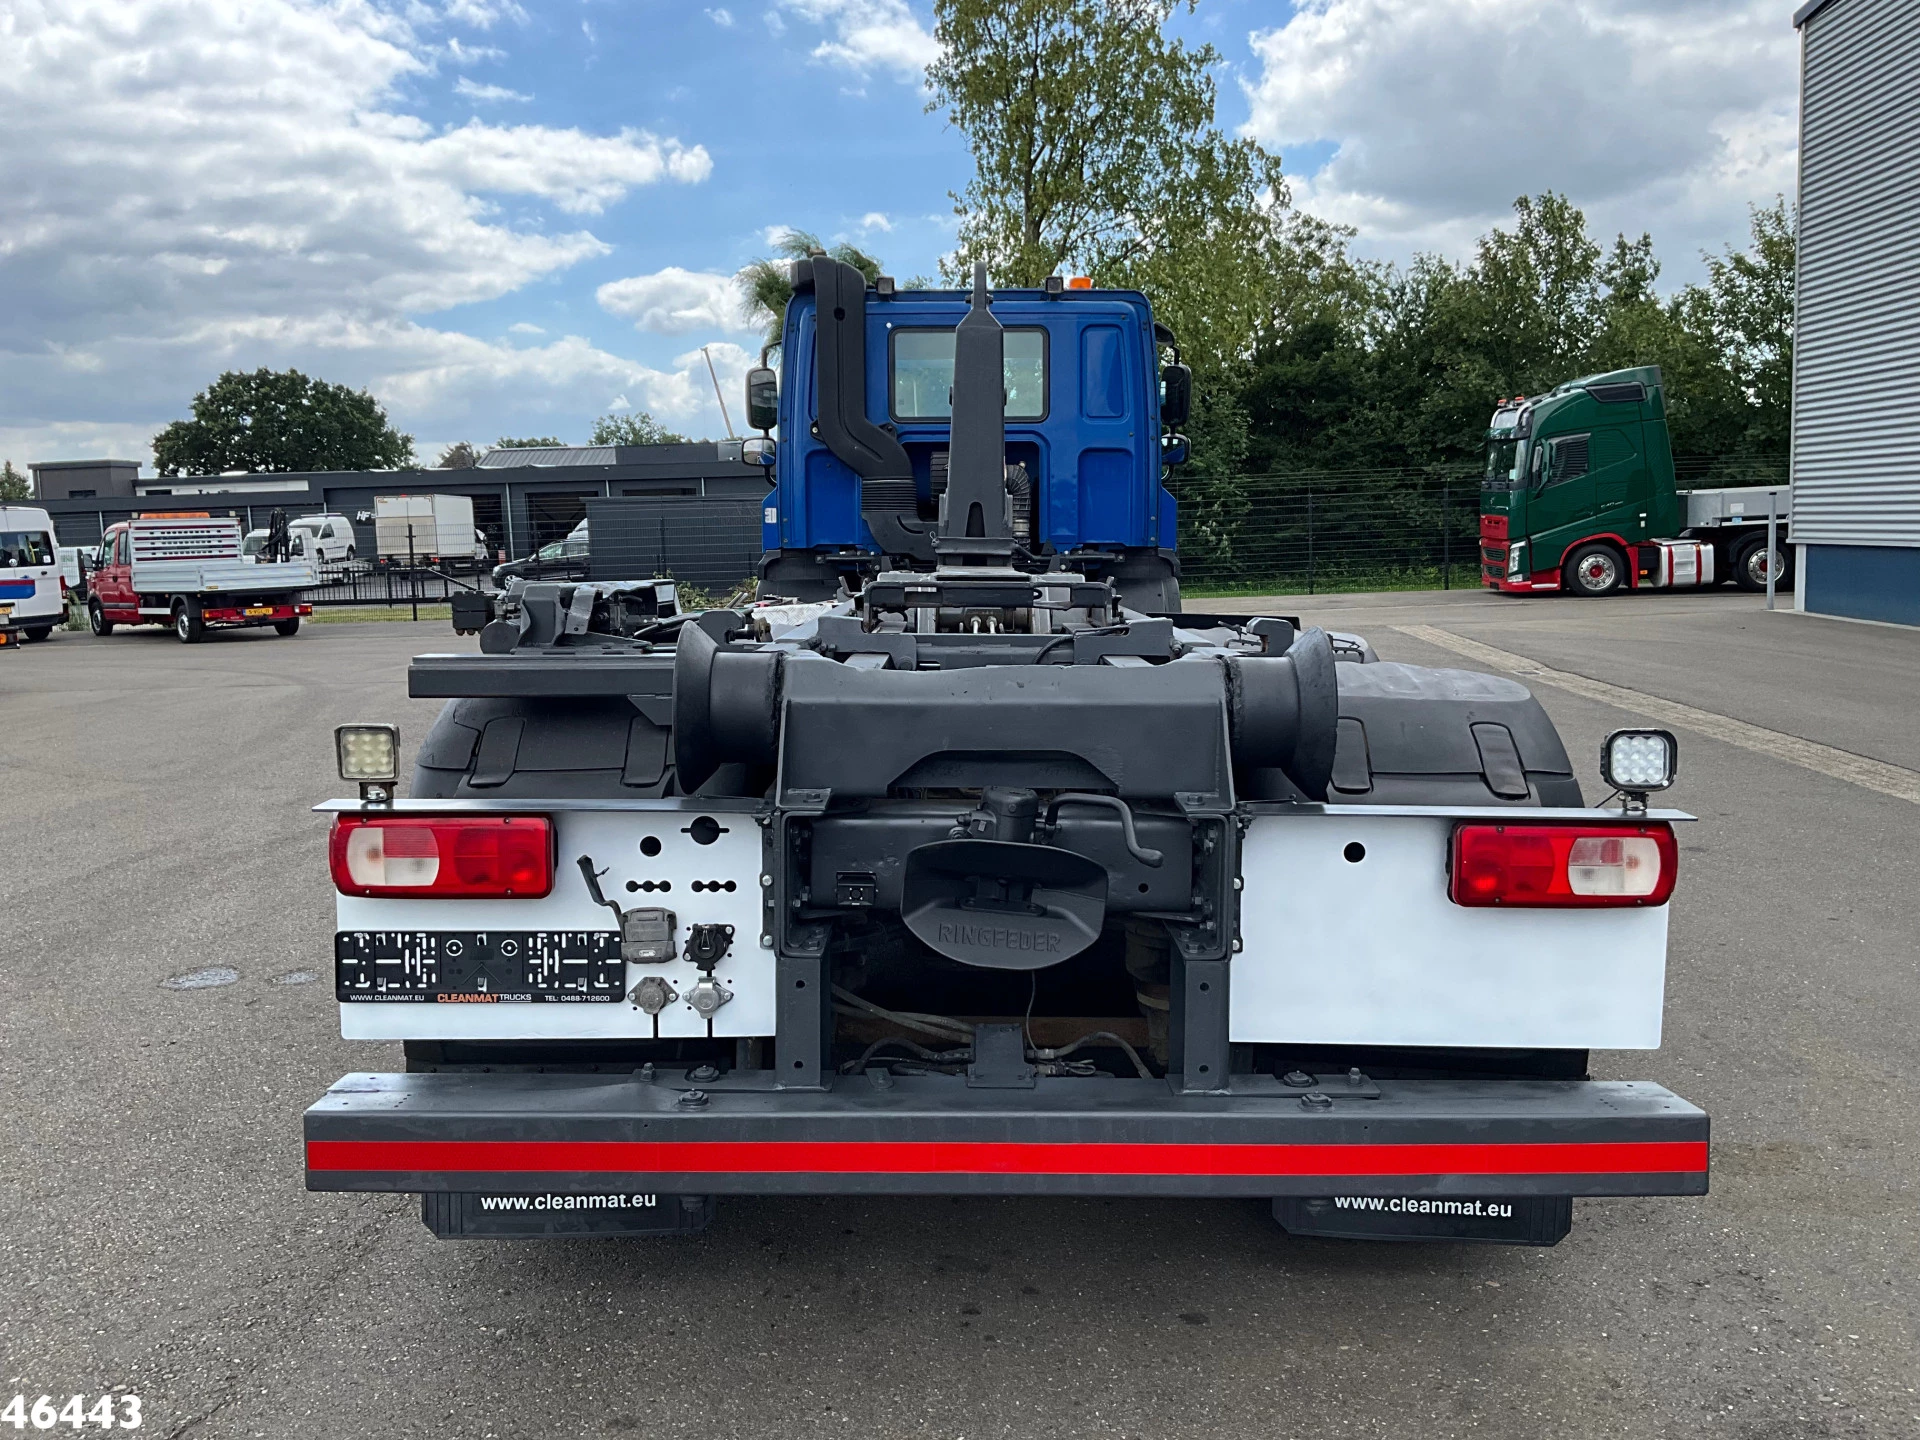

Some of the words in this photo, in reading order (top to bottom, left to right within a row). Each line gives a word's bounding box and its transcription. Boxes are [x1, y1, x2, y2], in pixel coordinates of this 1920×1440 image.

[938, 922, 1061, 953] RINGFEDER
[481, 1193, 656, 1210] www.cleanmat.eu
[1335, 1196, 1512, 1218] www.cleanmat.eu
